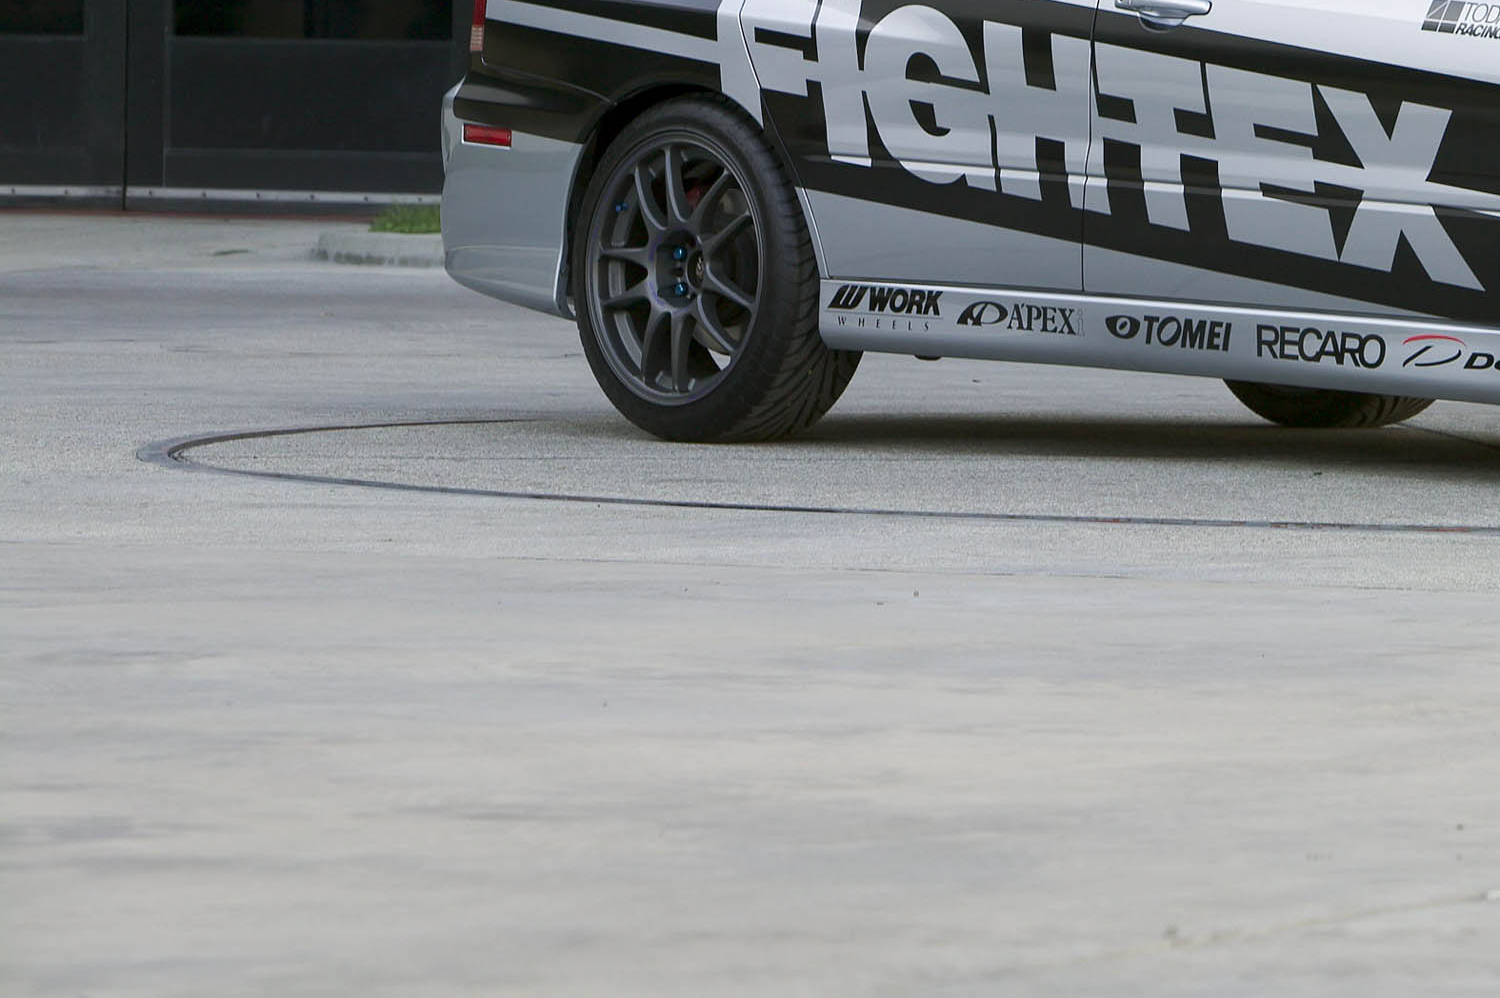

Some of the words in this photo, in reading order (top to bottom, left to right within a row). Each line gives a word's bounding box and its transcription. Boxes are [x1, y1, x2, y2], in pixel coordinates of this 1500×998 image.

[867, 286, 944, 316] WORK
[837, 315, 930, 332] WHEELS
[1143, 315, 1232, 352] TOMEI
[1256, 323, 1386, 369] RECARO
